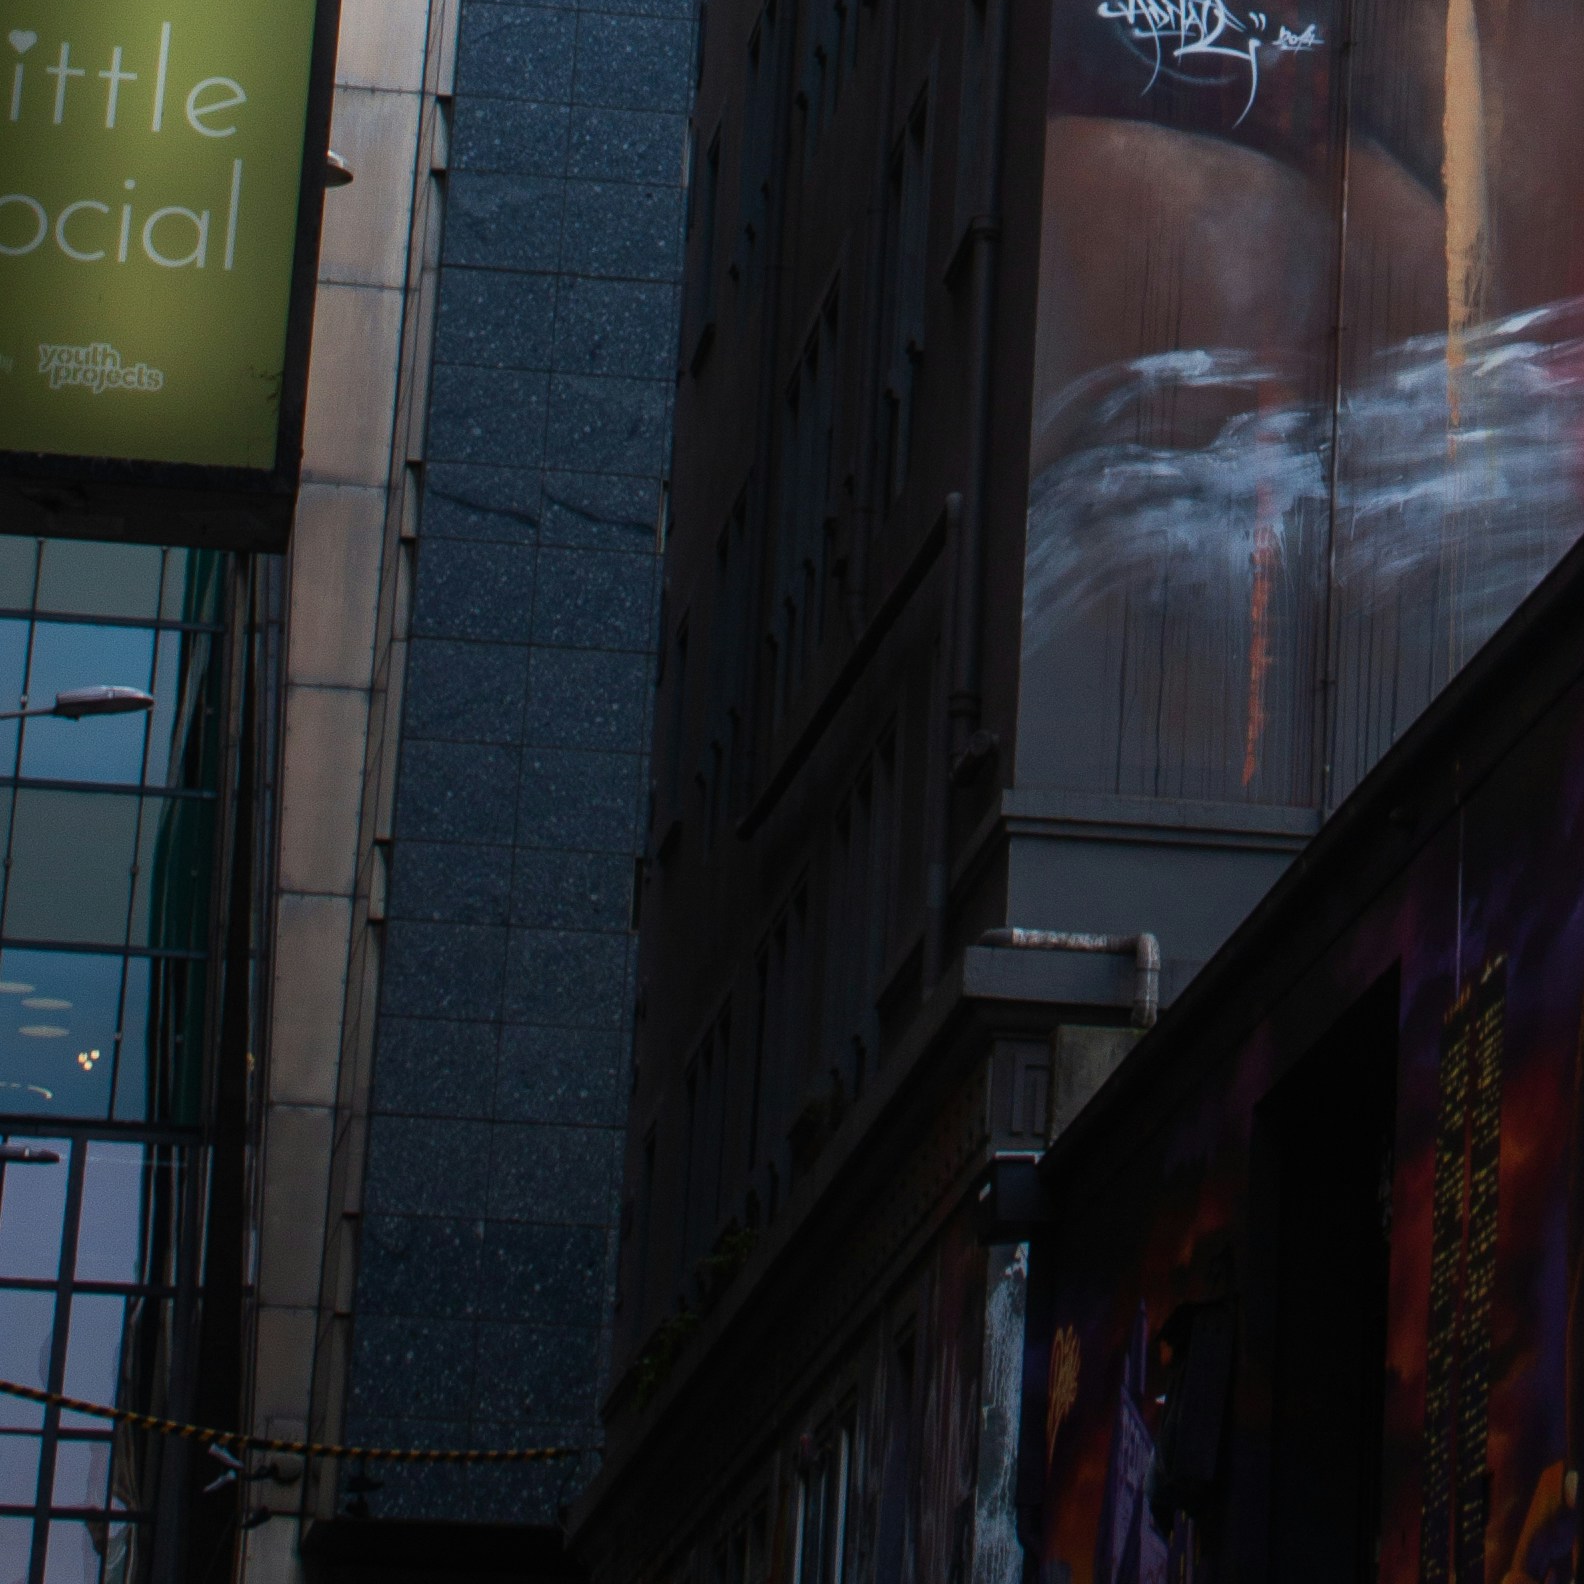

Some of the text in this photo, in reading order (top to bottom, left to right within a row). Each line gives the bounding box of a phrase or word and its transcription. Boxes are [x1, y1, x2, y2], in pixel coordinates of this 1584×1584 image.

[8, 21, 248, 138] ittle
[38, 342, 121, 373] youth
[50, 363, 165, 394] projects
